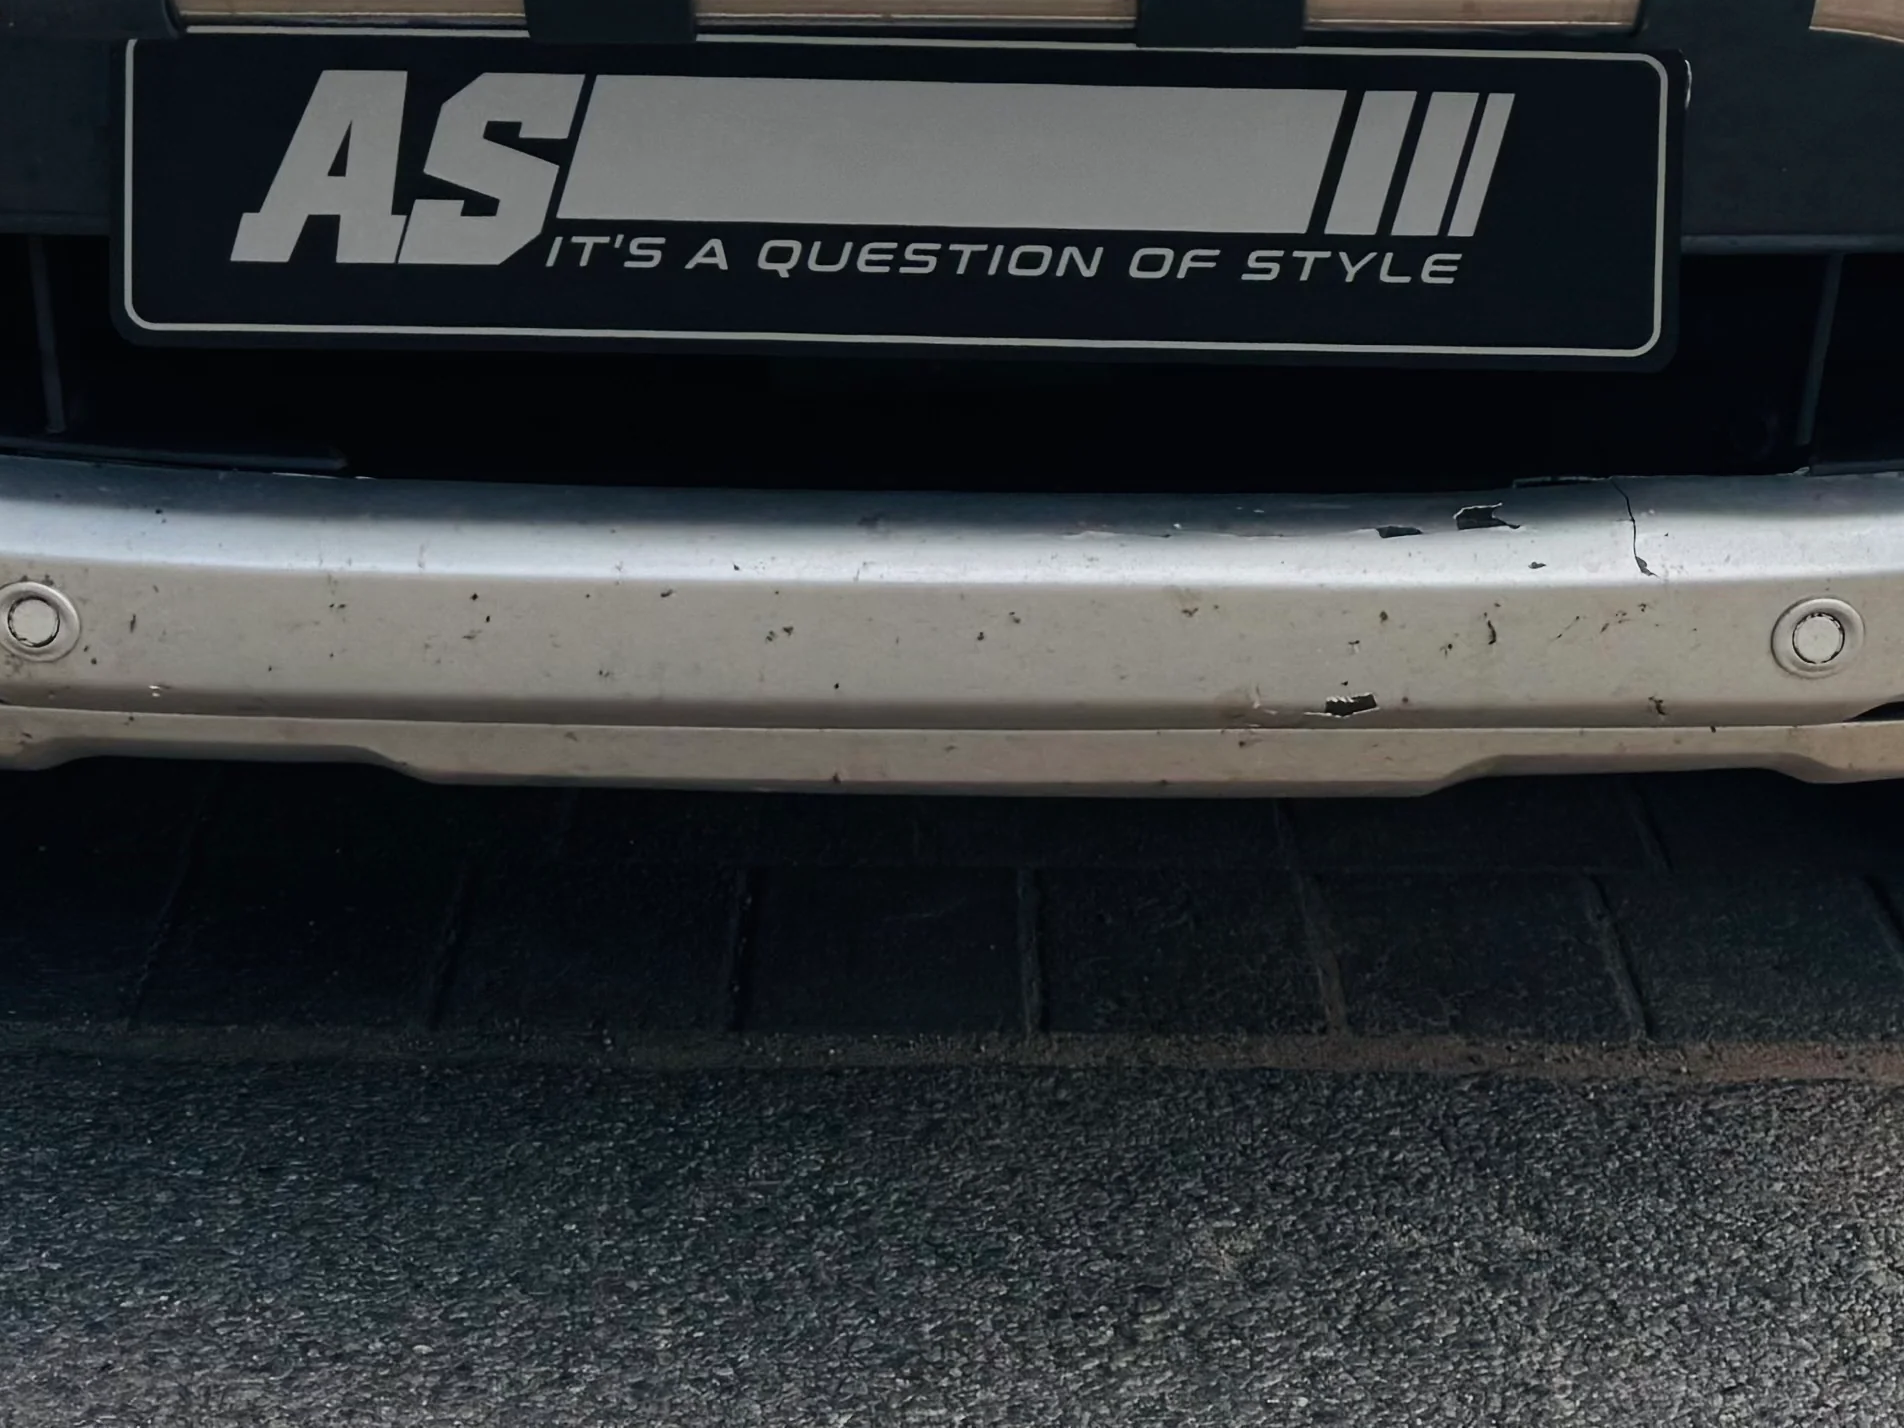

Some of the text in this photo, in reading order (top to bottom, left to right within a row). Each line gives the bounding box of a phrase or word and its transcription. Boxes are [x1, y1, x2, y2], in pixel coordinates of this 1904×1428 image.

[229, 69, 586, 267] AS
[545, 235, 1463, 286] IT'S A QUESTION OF STYLE
